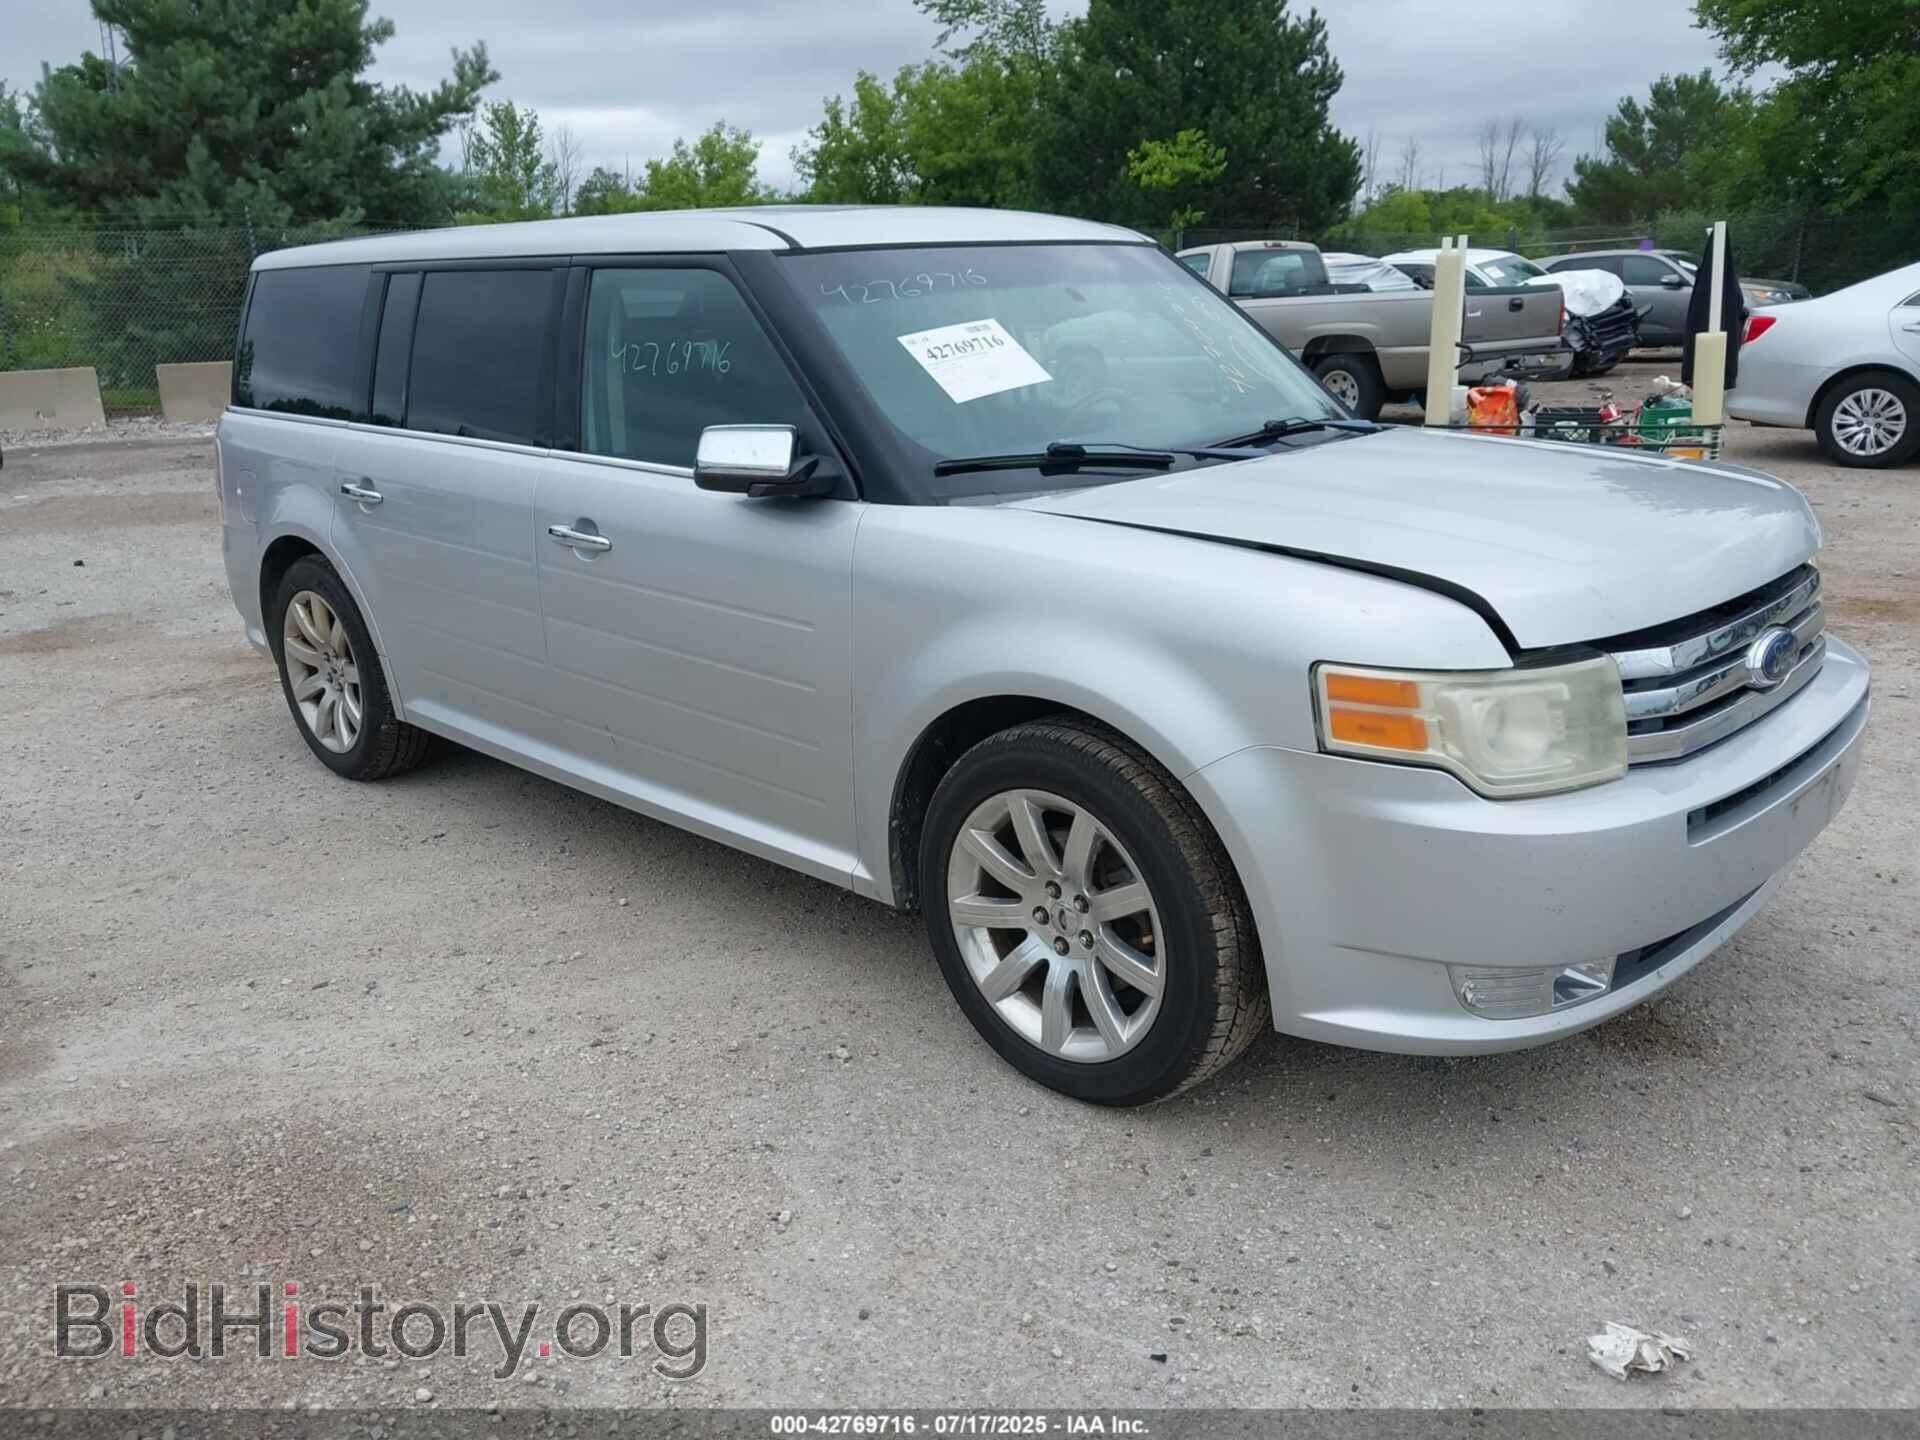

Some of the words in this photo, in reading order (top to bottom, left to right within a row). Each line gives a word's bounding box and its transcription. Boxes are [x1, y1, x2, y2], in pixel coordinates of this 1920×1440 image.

[820, 268, 987, 304] 42769716
[610, 335, 731, 376] 42769716
[925, 334, 1005, 360] 42769716
